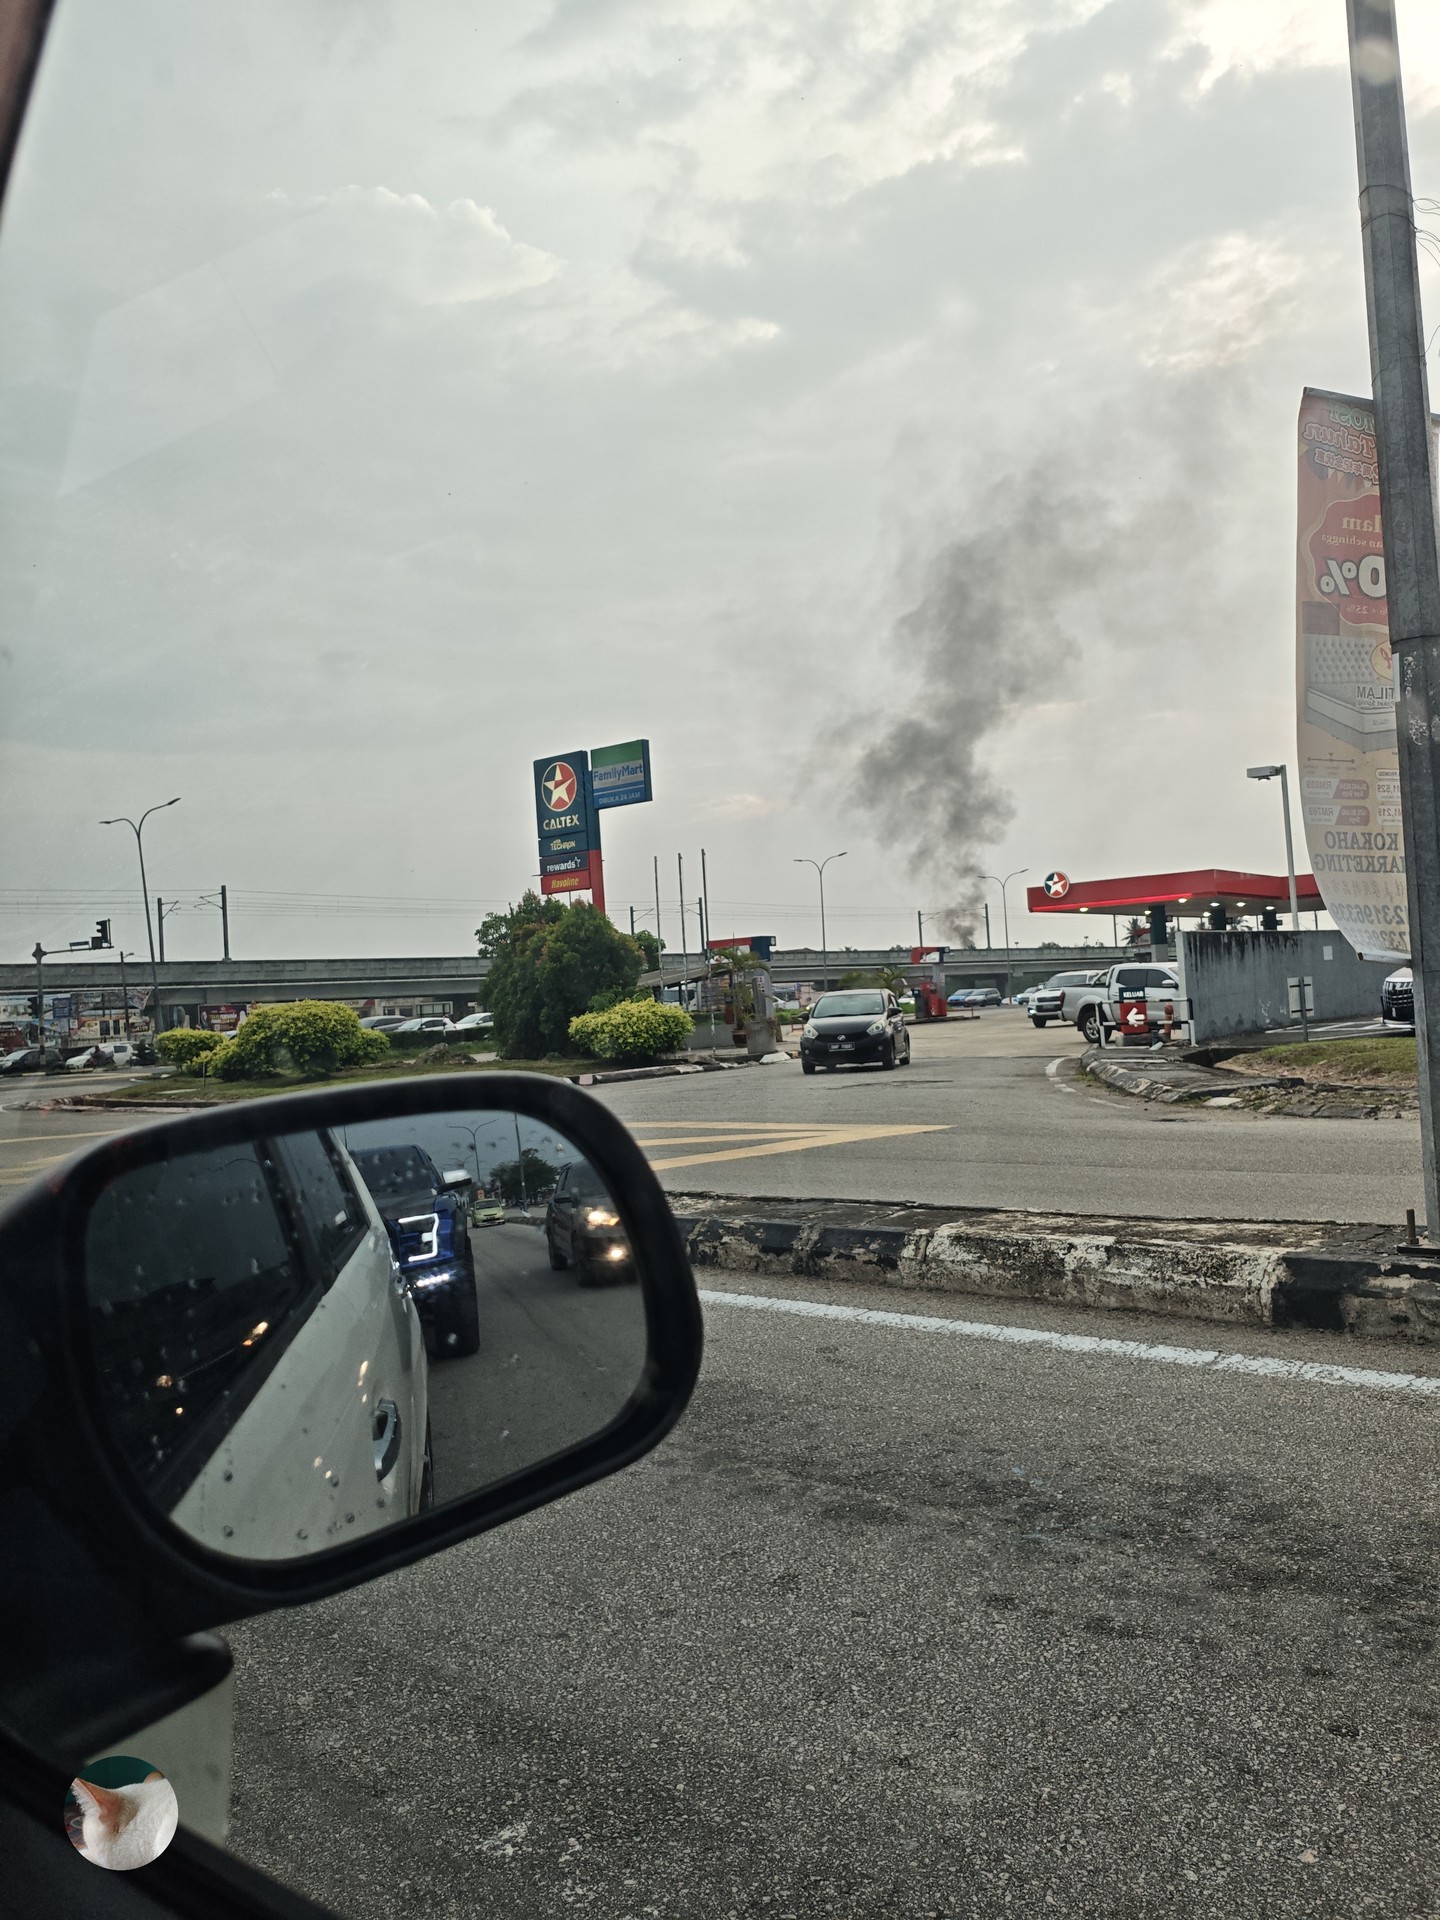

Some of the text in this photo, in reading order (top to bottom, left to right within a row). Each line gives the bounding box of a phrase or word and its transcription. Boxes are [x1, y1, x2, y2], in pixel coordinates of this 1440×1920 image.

[593, 763, 643, 782] FamilyMart
[543, 814, 580, 831] CALTEX
[546, 860, 576, 872] rewards
[551, 877, 579, 889] Havoline
